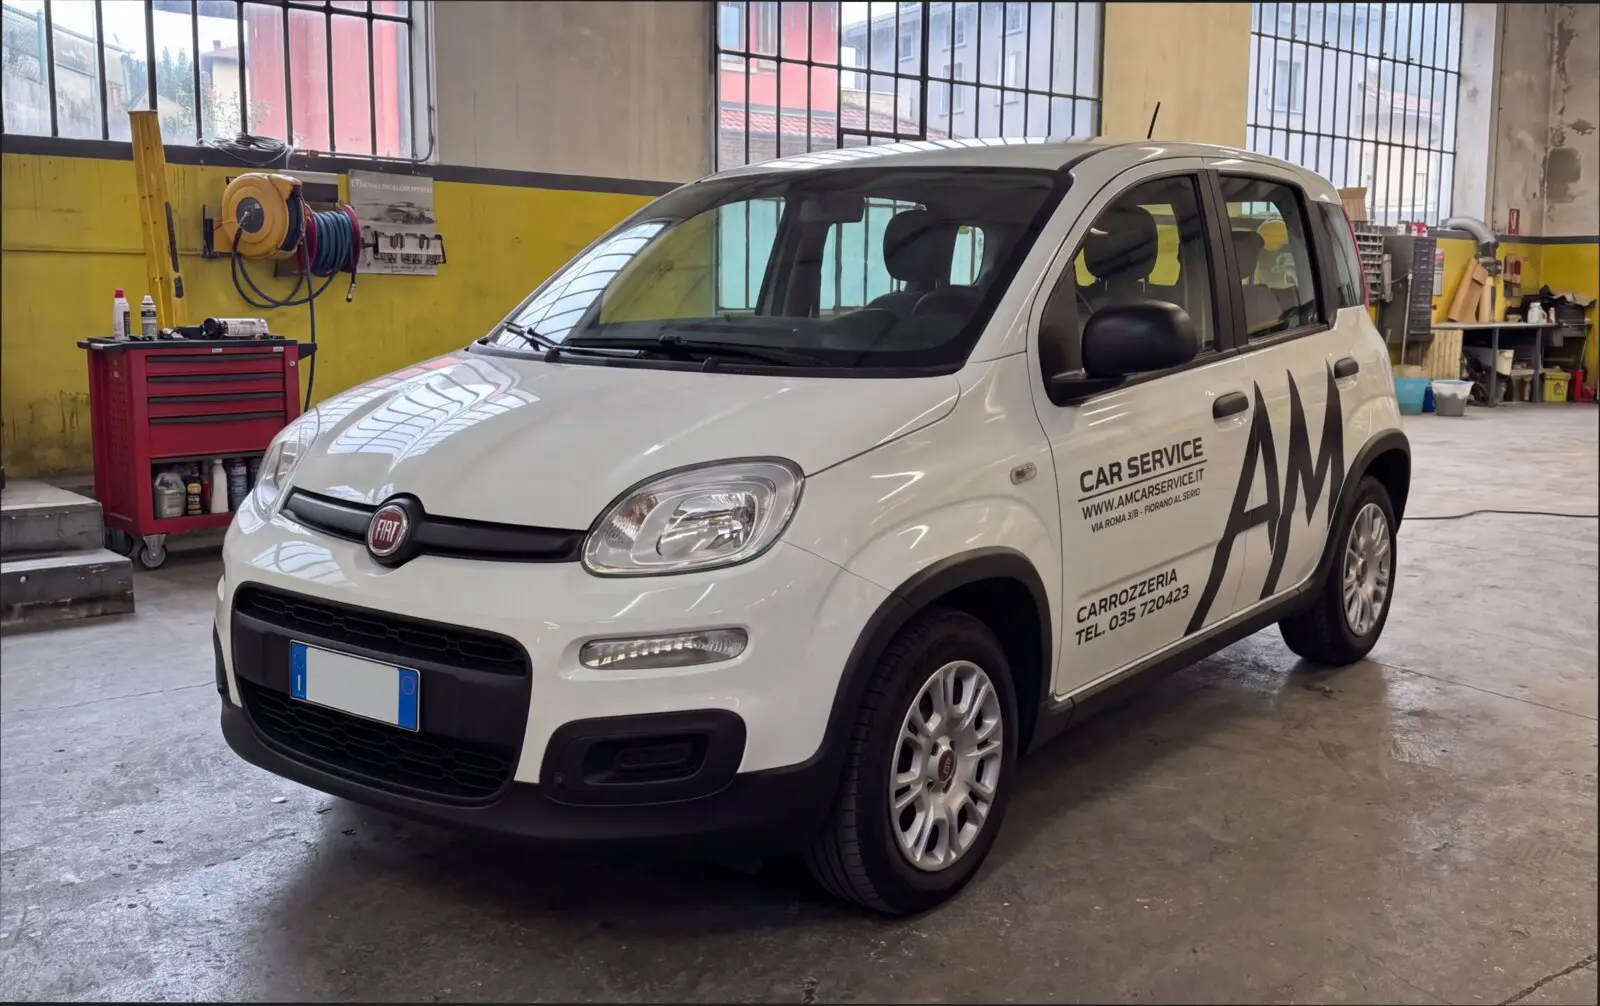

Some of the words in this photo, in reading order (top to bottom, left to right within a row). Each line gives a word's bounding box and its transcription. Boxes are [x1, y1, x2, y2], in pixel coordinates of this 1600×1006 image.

[1080, 461, 1123, 493] CAR
[1127, 437, 1204, 479] SERVICE
[1081, 468, 1205, 520] WWW.AMCARSERVICE.IT
[1091, 521, 1104, 533] VIA
[1104, 513, 1126, 529] ROMA
[1127, 509, 1139, 521] 3/B
[1144, 497, 1174, 515] FIORANO
[1173, 493, 1182, 505] AL
[1182, 487, 1201, 501] SERIO
[1183, 359, 1345, 638] AM
[375, 518, 401, 543] FIAT
[1075, 622, 1106, 646] TEL.
[1108, 606, 1136, 631] 035
[1140, 584, 1190, 618] 720423
[1076, 568, 1178, 624] CARROZZERIA
